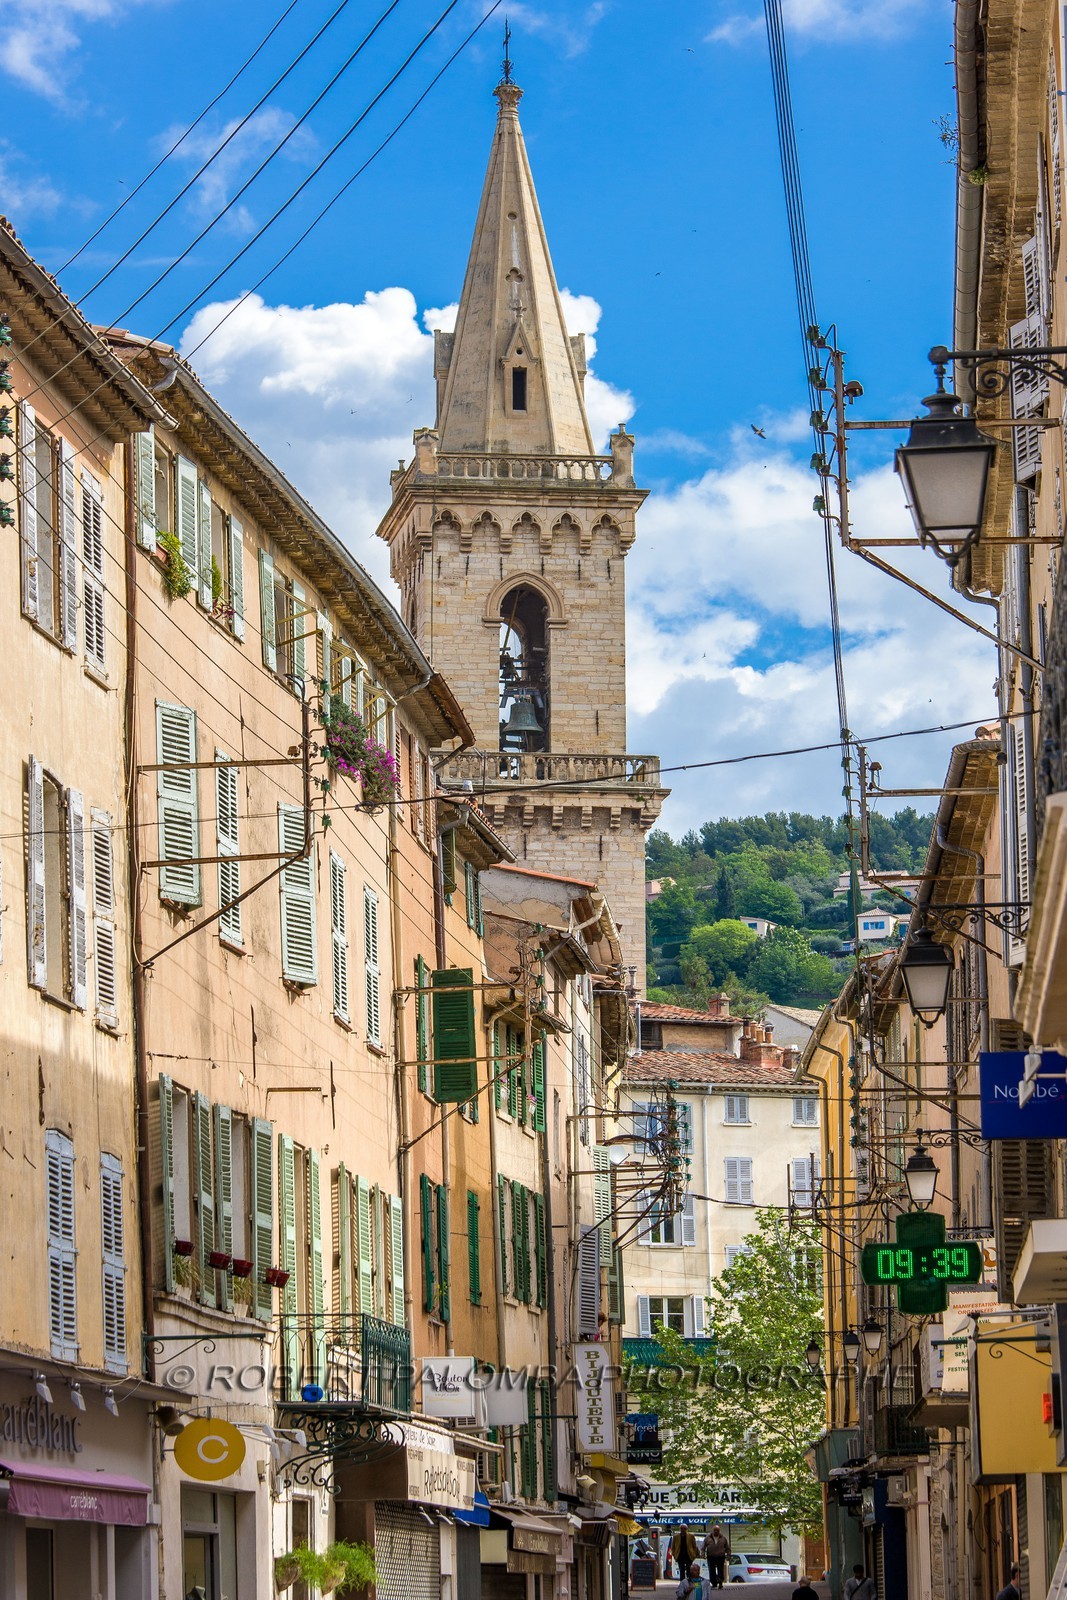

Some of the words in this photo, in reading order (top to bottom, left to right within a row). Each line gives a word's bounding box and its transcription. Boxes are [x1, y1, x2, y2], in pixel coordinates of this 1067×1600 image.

[994, 1083, 1059, 1098] Nobé
[877, 1247, 968, 1278] 09:39
[583, 1350, 604, 1445] BIJOUTERIE
[0, 1396, 82, 1453] arréblanc
[197, 1435, 229, 1464] C
